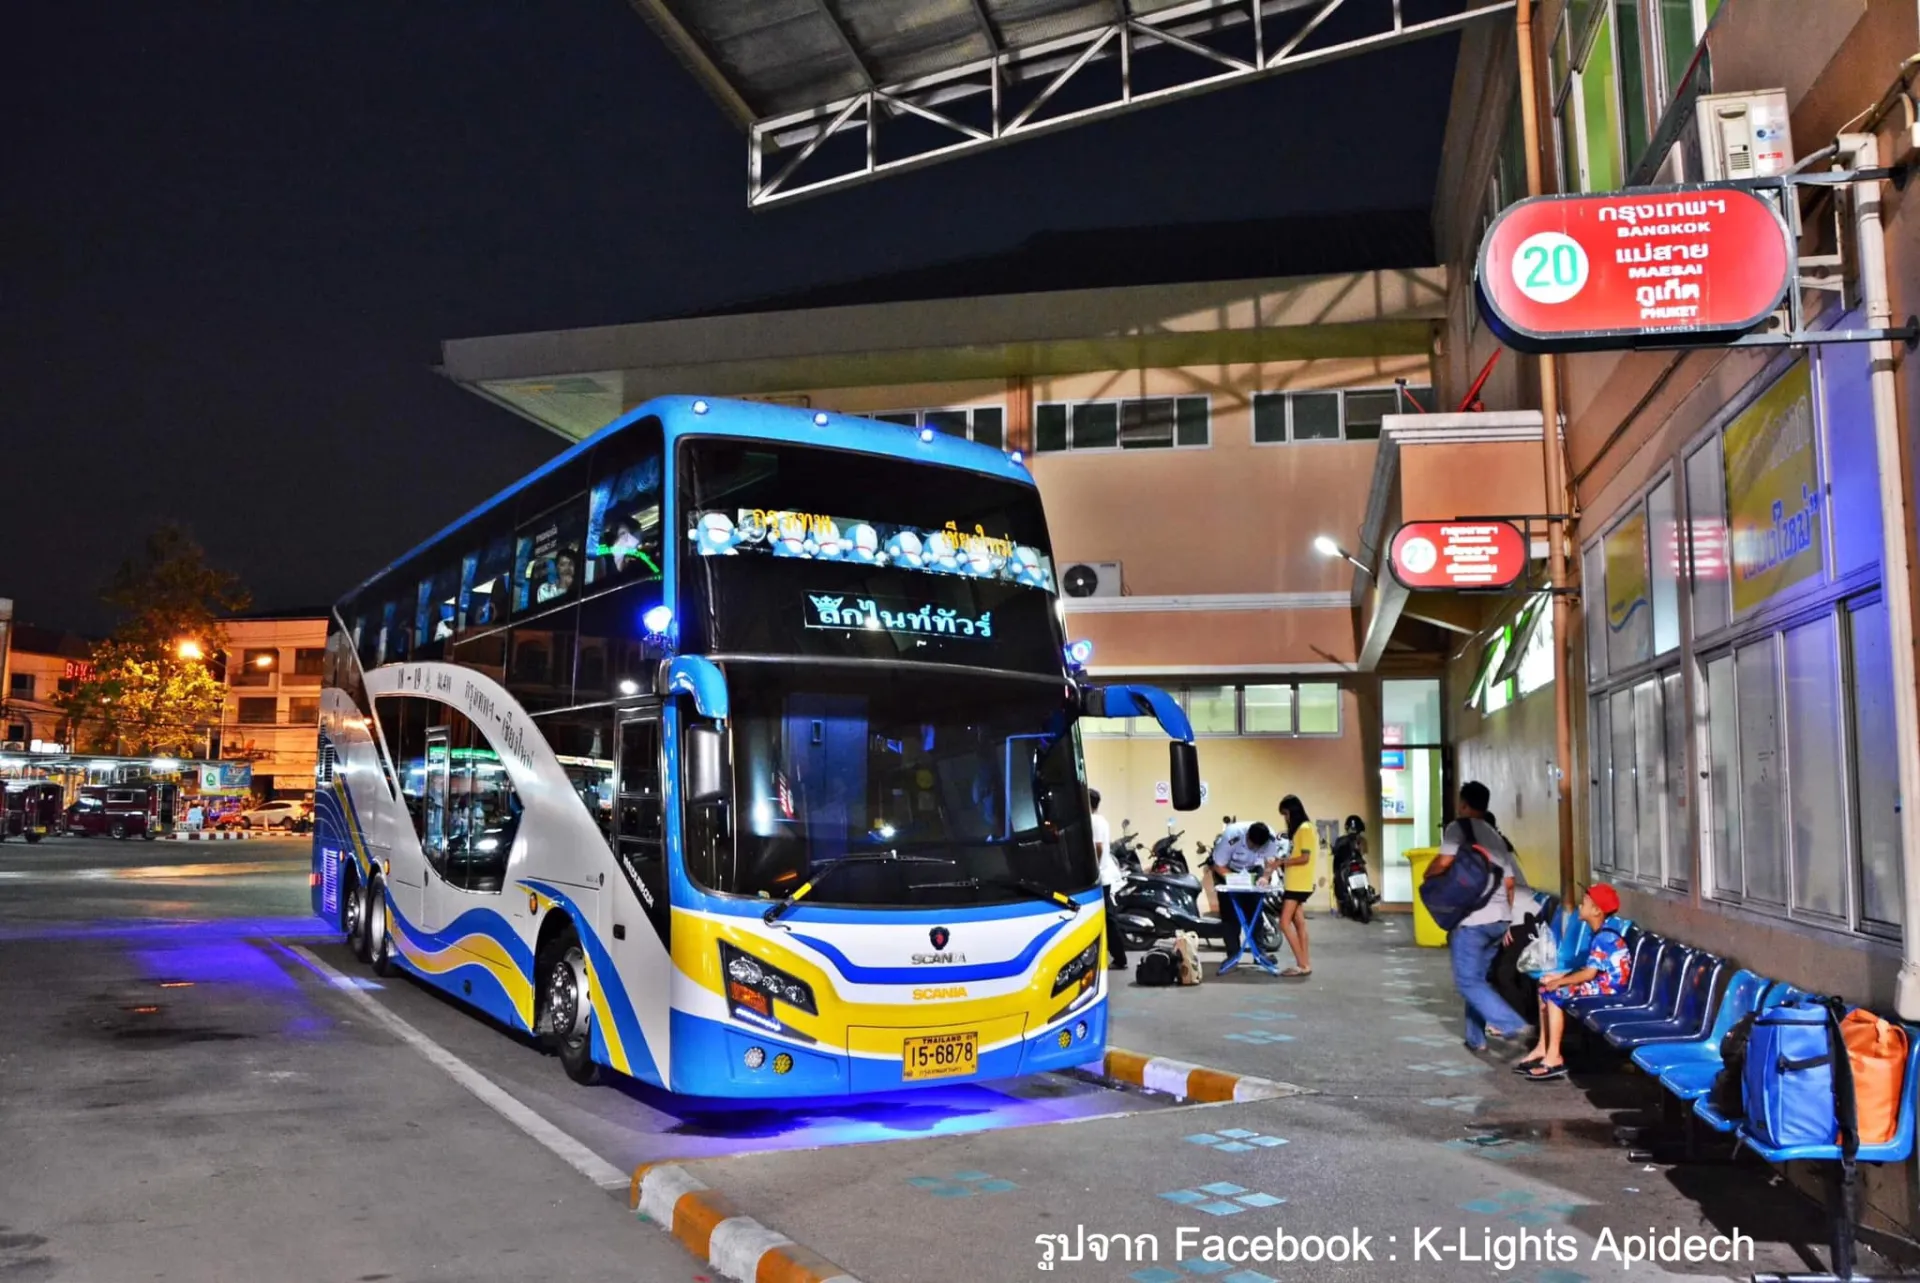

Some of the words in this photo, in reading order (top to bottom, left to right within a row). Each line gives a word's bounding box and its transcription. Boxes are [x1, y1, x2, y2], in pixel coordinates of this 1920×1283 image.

[1598, 199, 1726, 226] กรุงเทพฯ
[1616, 221, 1711, 239] BANGKOK
[1615, 242, 1709, 264] แม่สาย
[1523, 243, 1578, 288] 20
[1628, 264, 1703, 279] MAESAI
[1636, 279, 1700, 307] ภูเก็ต
[1640, 305, 1699, 320] PHUKET
[911, 952, 967, 965] SCANIA
[912, 986, 969, 1000] SCANIA
[922, 1034, 963, 1045] THAILAND
[911, 1041, 974, 1068] 15-6878
